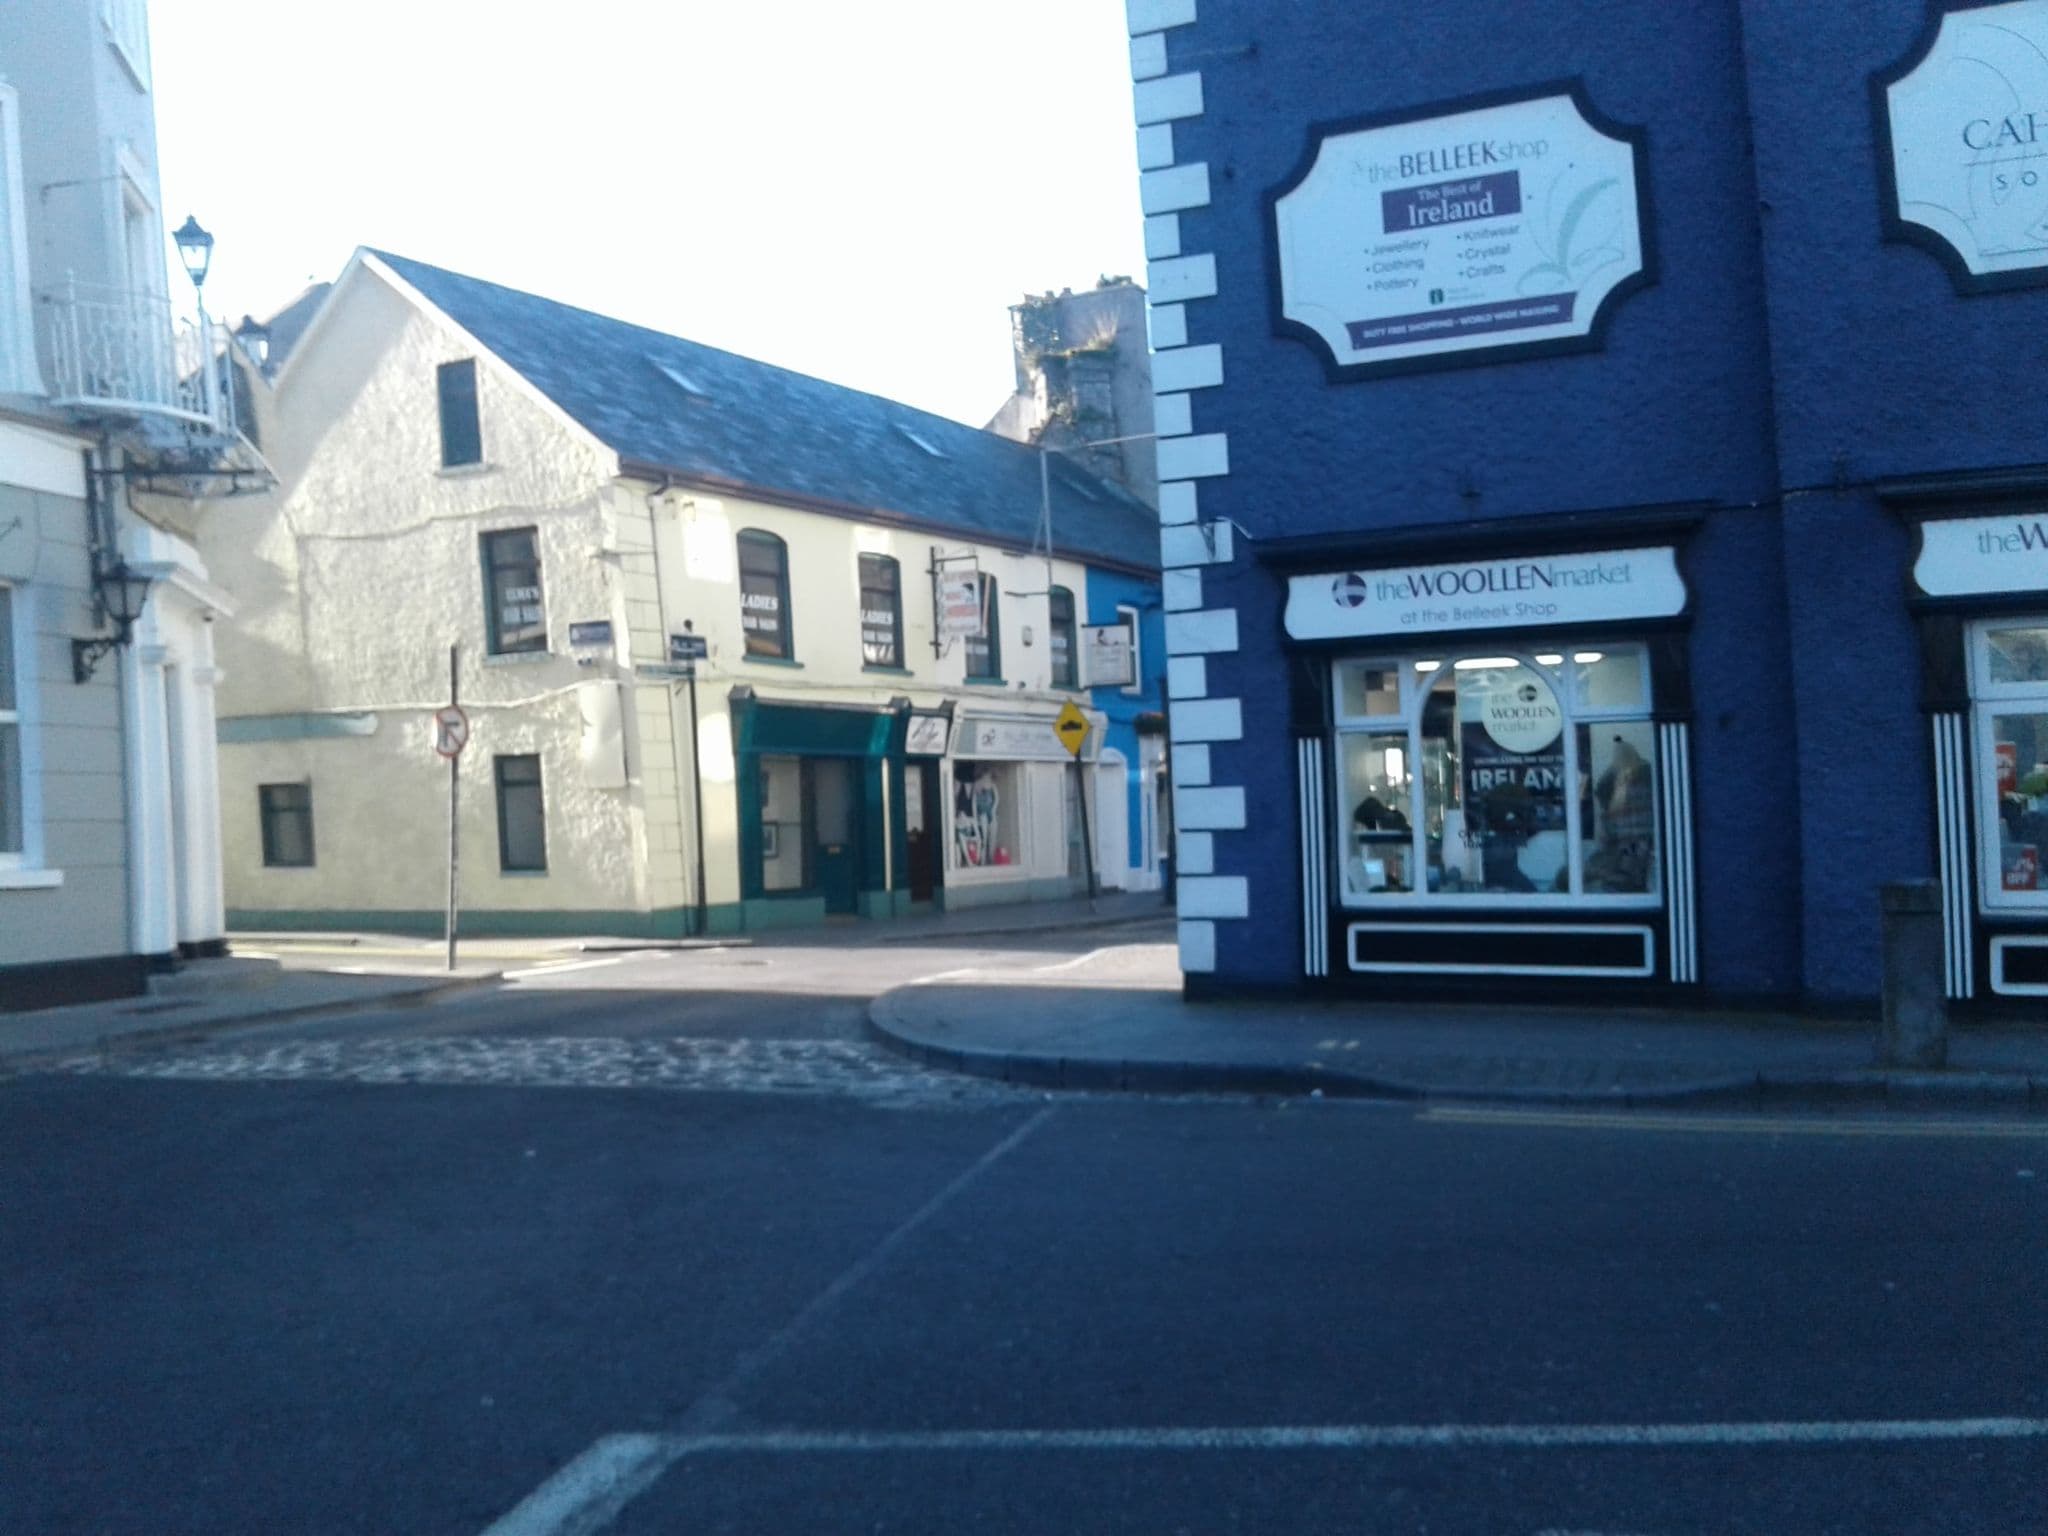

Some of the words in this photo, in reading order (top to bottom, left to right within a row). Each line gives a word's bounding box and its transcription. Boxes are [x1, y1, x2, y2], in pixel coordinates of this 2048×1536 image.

[1417, 187, 1440, 201] The
[1441, 183, 1466, 198] Best
[1469, 180, 1482, 193] of
[1408, 191, 1494, 227] Ireland
[1371, 238, 1430, 256] Jewellery
[1464, 243, 1511, 260] Crystal
[1372, 257, 1425, 274] Clothing
[1466, 263, 1506, 279] Crafts
[1373, 277, 1418, 291] Pottery
[740, 593, 778, 611] LADIES
[1401, 608, 1420, 625] at
[1422, 605, 1448, 623] the
[1453, 604, 1510, 622] Belleek
[1515, 600, 1558, 618] Shop
[1471, 766, 1564, 792] IRELAN
